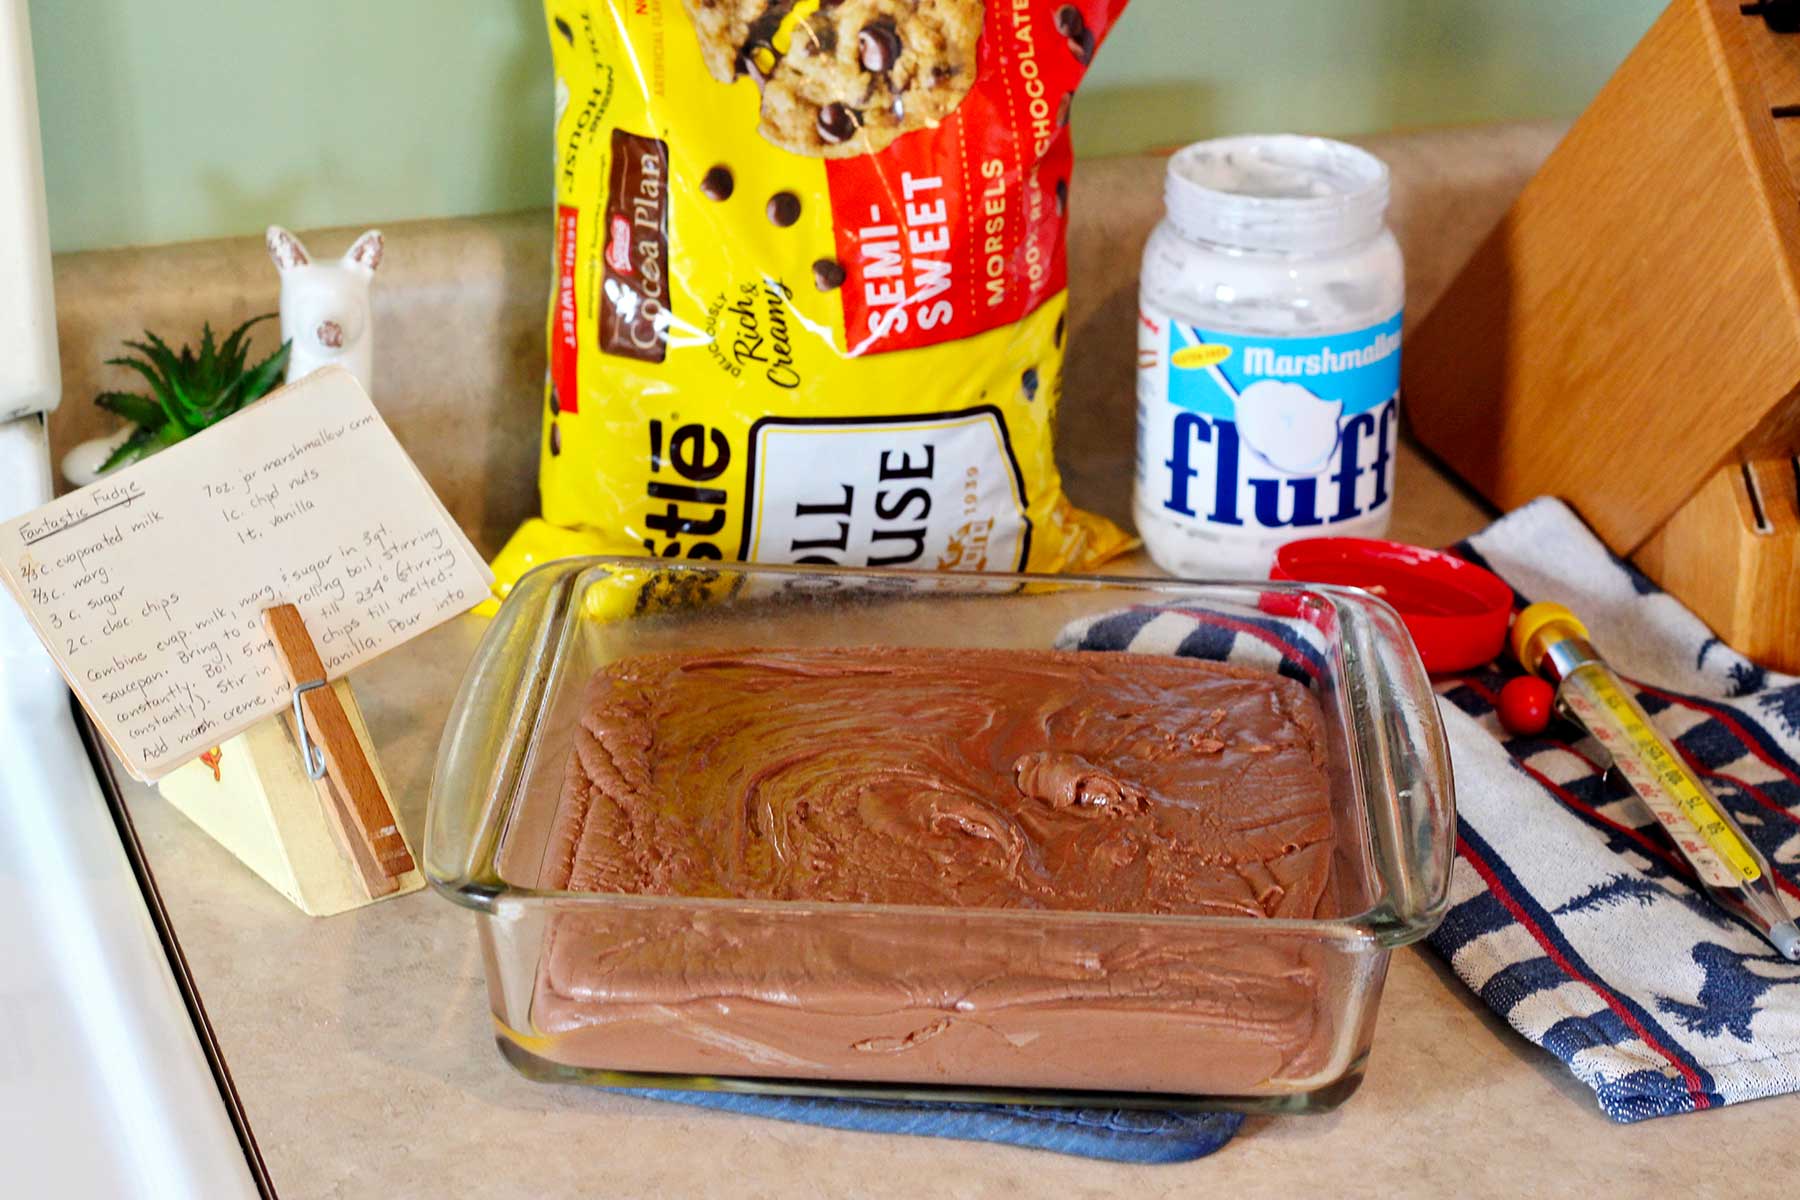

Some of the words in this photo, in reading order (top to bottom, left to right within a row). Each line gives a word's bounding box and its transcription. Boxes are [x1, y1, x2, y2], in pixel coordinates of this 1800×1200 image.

[1012, 0, 1050, 158] CHOCOLATE
[564, 88, 602, 184] HOUSE
[633, 153, 661, 232] Plan
[859, 204, 909, 338] SEMI-
[901, 171, 954, 330] SWEET
[982, 158, 1007, 307] MORSELS
[561, 215, 577, 349] SEMI-SWEET
[630, 239, 661, 349] Cocoa
[706, 291, 742, 378] DELICOUSLY
[727, 297, 768, 367] Rich
[763, 277, 801, 390] Creamy
[263, 426, 345, 472] marshmallow
[289, 467, 320, 490] nuts
[1164, 397, 1397, 528] fluff
[18, 507, 89, 541] Fantastic
[92, 481, 142, 509] Fudge
[56, 524, 124, 573] evaporated
[132, 509, 165, 533] milk
[271, 498, 316, 528] vanilla
[790, 483, 855, 566] LL
[867, 443, 936, 567] USE
[88, 585, 125, 616] sugar
[298, 577, 345, 605] rolling
[382, 527, 444, 561] stirring
[87, 651, 148, 682] Combine
[157, 628, 193, 651] evap.
[292, 554, 333, 586] sugar
[339, 545, 358, 558] in
[141, 592, 181, 622] chips
[320, 601, 341, 618] till
[322, 618, 361, 645] chips
[367, 602, 391, 620] till
[400, 568, 454, 604] melted.
[324, 635, 383, 670] vanilla.
[388, 613, 422, 635] Pour
[435, 588, 465, 611] into
[102, 669, 169, 704] saucepan.
[177, 639, 225, 665] Bring
[224, 627, 242, 640] to
[116, 682, 197, 723] constantly.
[203, 653, 233, 679] Boil
[216, 674, 248, 695] Stir
[256, 665, 272, 678] in
[143, 736, 169, 762] Add
